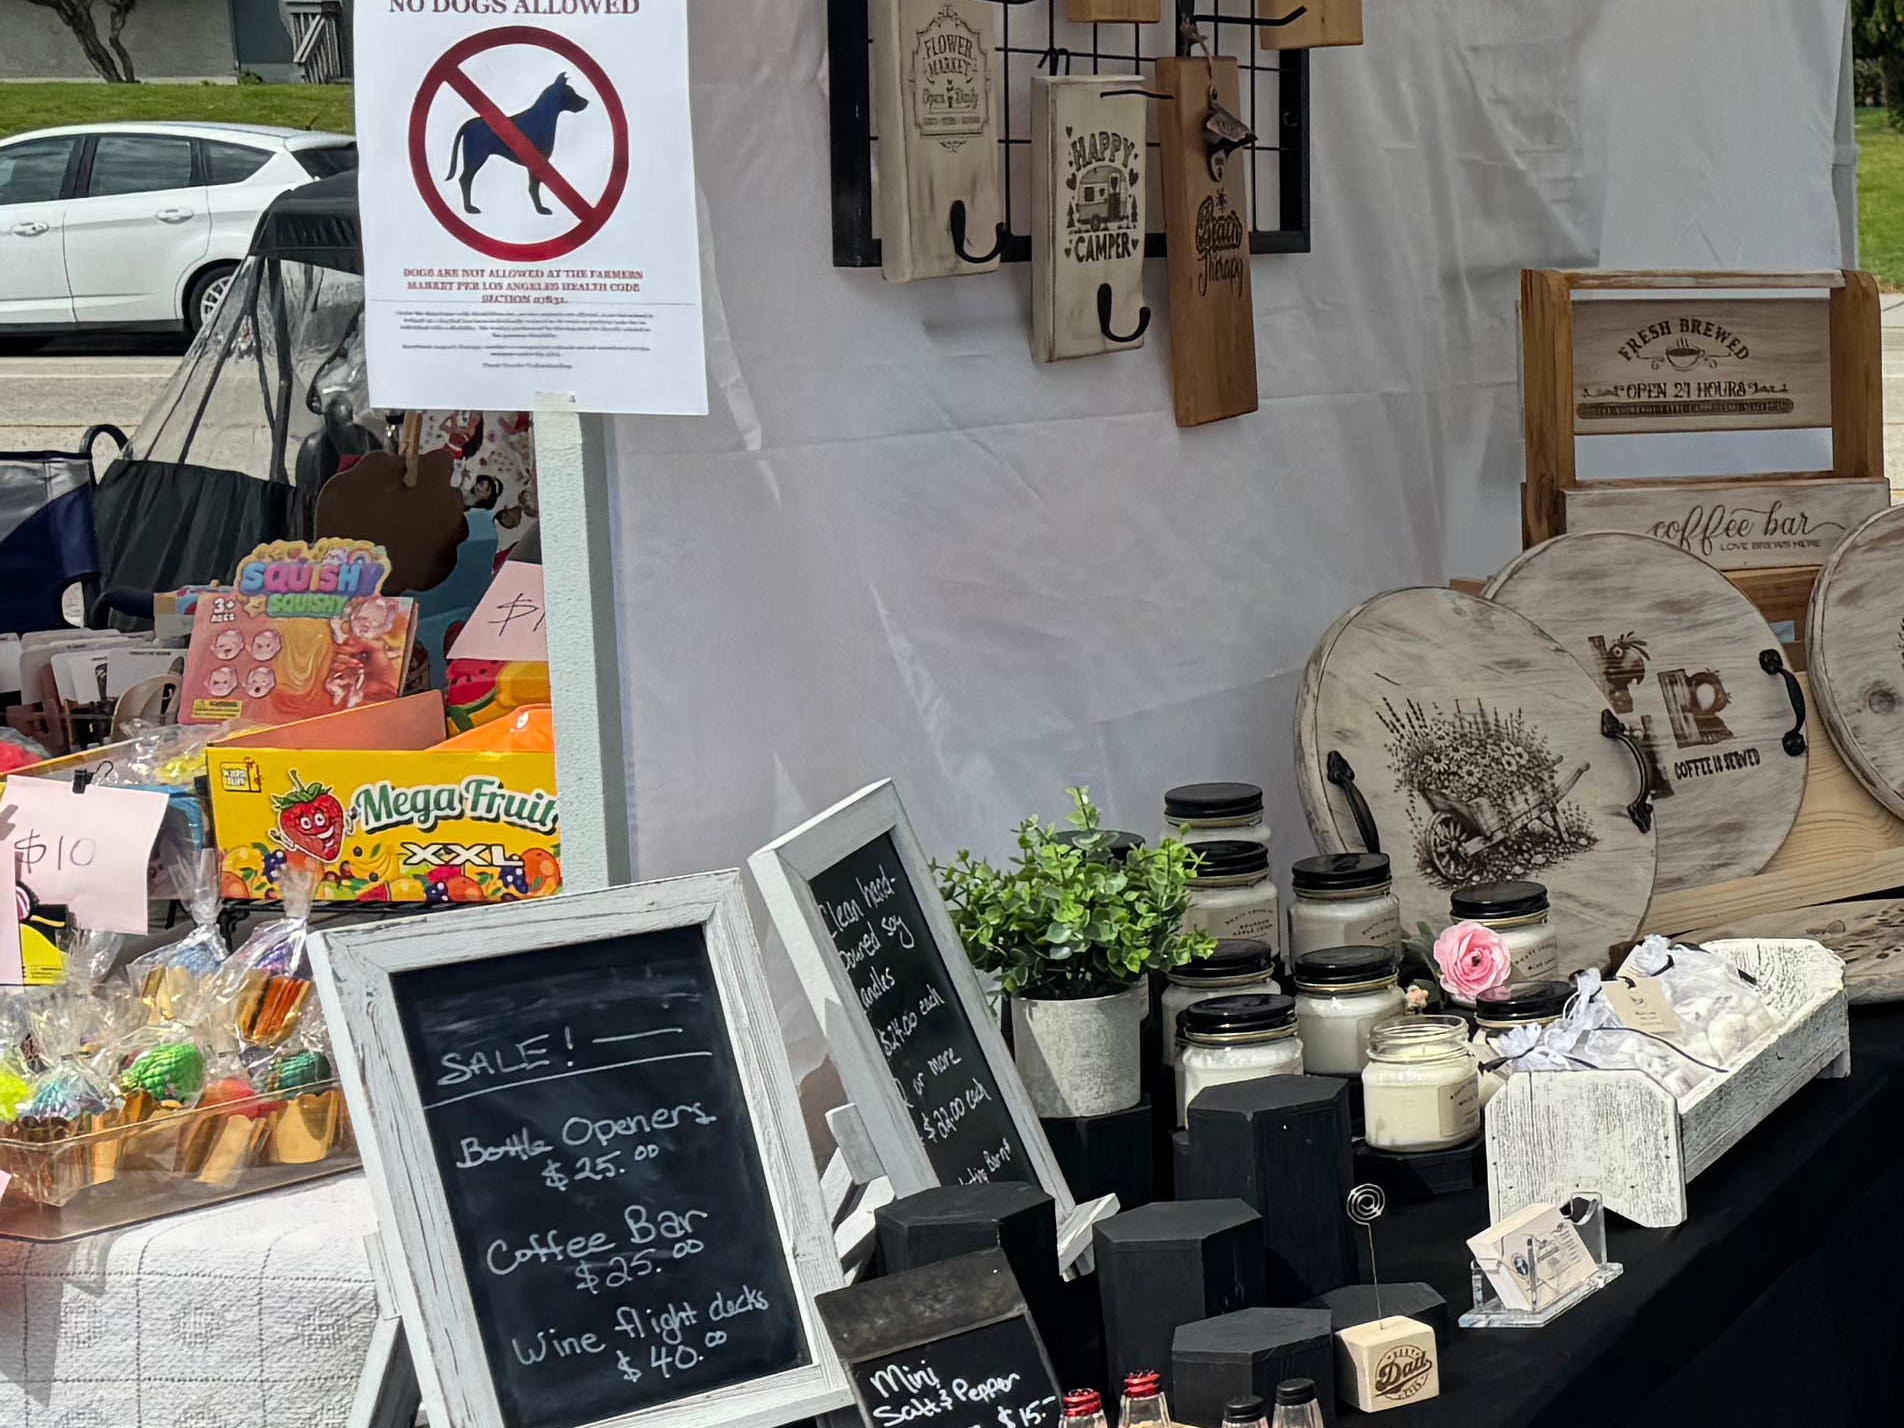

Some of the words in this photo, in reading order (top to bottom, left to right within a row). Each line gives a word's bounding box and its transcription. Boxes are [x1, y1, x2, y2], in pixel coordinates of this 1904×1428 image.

[924, 35, 972, 59] FLOWER
[1071, 131, 1135, 170] HAPPY
[1074, 232, 1130, 263] CAMPER
[1618, 320, 1672, 361] FRESH
[1679, 319, 1749, 360] BREWED
[1626, 383, 1667, 399] OPEN
[1697, 381, 1746, 398] HOURS
[1651, 504, 1751, 556] coffee
[1763, 500, 1845, 535] bar
[1721, 541, 1748, 551] LOVE
[1752, 540, 1791, 550] BREWS
[240, 562, 384, 594] SQUISHY
[213, 597, 235, 614] 3+
[268, 594, 350, 615] SQUISHY
[1675, 756, 1713, 779] COFFEE
[1714, 754, 1723, 772] IS
[1725, 748, 1760, 771] SERVED
[355, 784, 456, 822] Mega
[14, 828, 96, 874] $10
[400, 842, 525, 866] XXL
[436, 1027, 577, 1086] SALE!
[456, 1131, 553, 1169] Bottle
[563, 1101, 717, 1148] Openers
[486, 1229, 616, 1275] Coffee
[624, 1204, 708, 1245] Bar
[513, 1328, 606, 1367] Wine
[614, 1304, 698, 1346] flight
[870, 1359, 940, 1398] Mini
[1375, 1351, 1426, 1391] Dad
[873, 1398, 941, 1427] Salt
[952, 1373, 1020, 1403] Pepper
